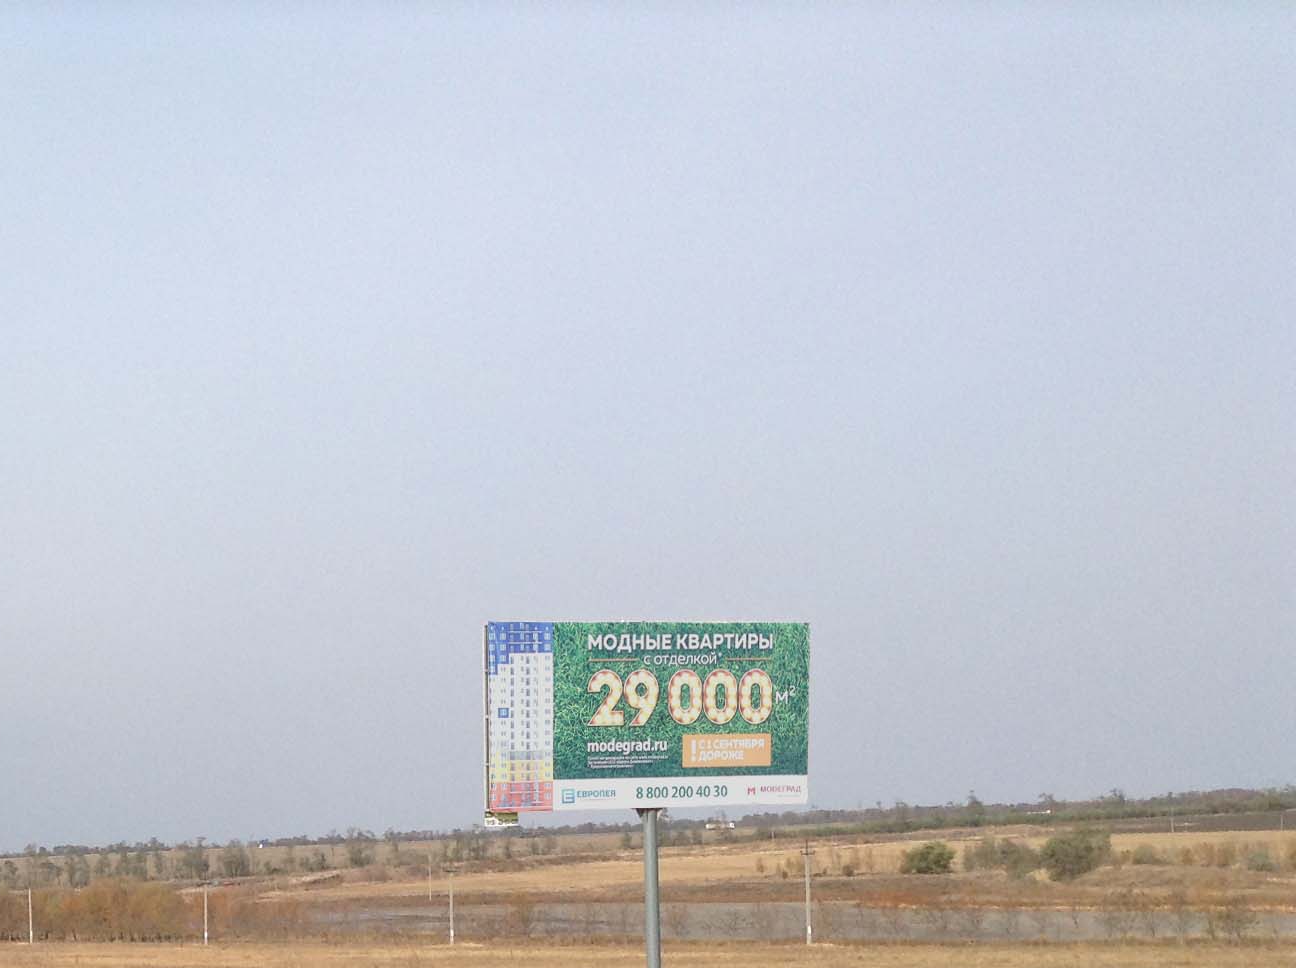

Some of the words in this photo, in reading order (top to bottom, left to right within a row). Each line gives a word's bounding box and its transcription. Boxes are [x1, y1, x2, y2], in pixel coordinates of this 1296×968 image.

[588, 634, 672, 653] МОДНЫЕ
[677, 633, 773, 650] КВАРТИРЫ
[587, 669, 660, 727] 29
[667, 668, 773, 725] 000
[587, 738, 668, 755] modegrad.ru
[636, 787, 644, 799] 8
[646, 787, 668, 799] 800
[671, 786, 693, 798] 200
[695, 785, 710, 798] 40
[713, 785, 728, 797] 30
